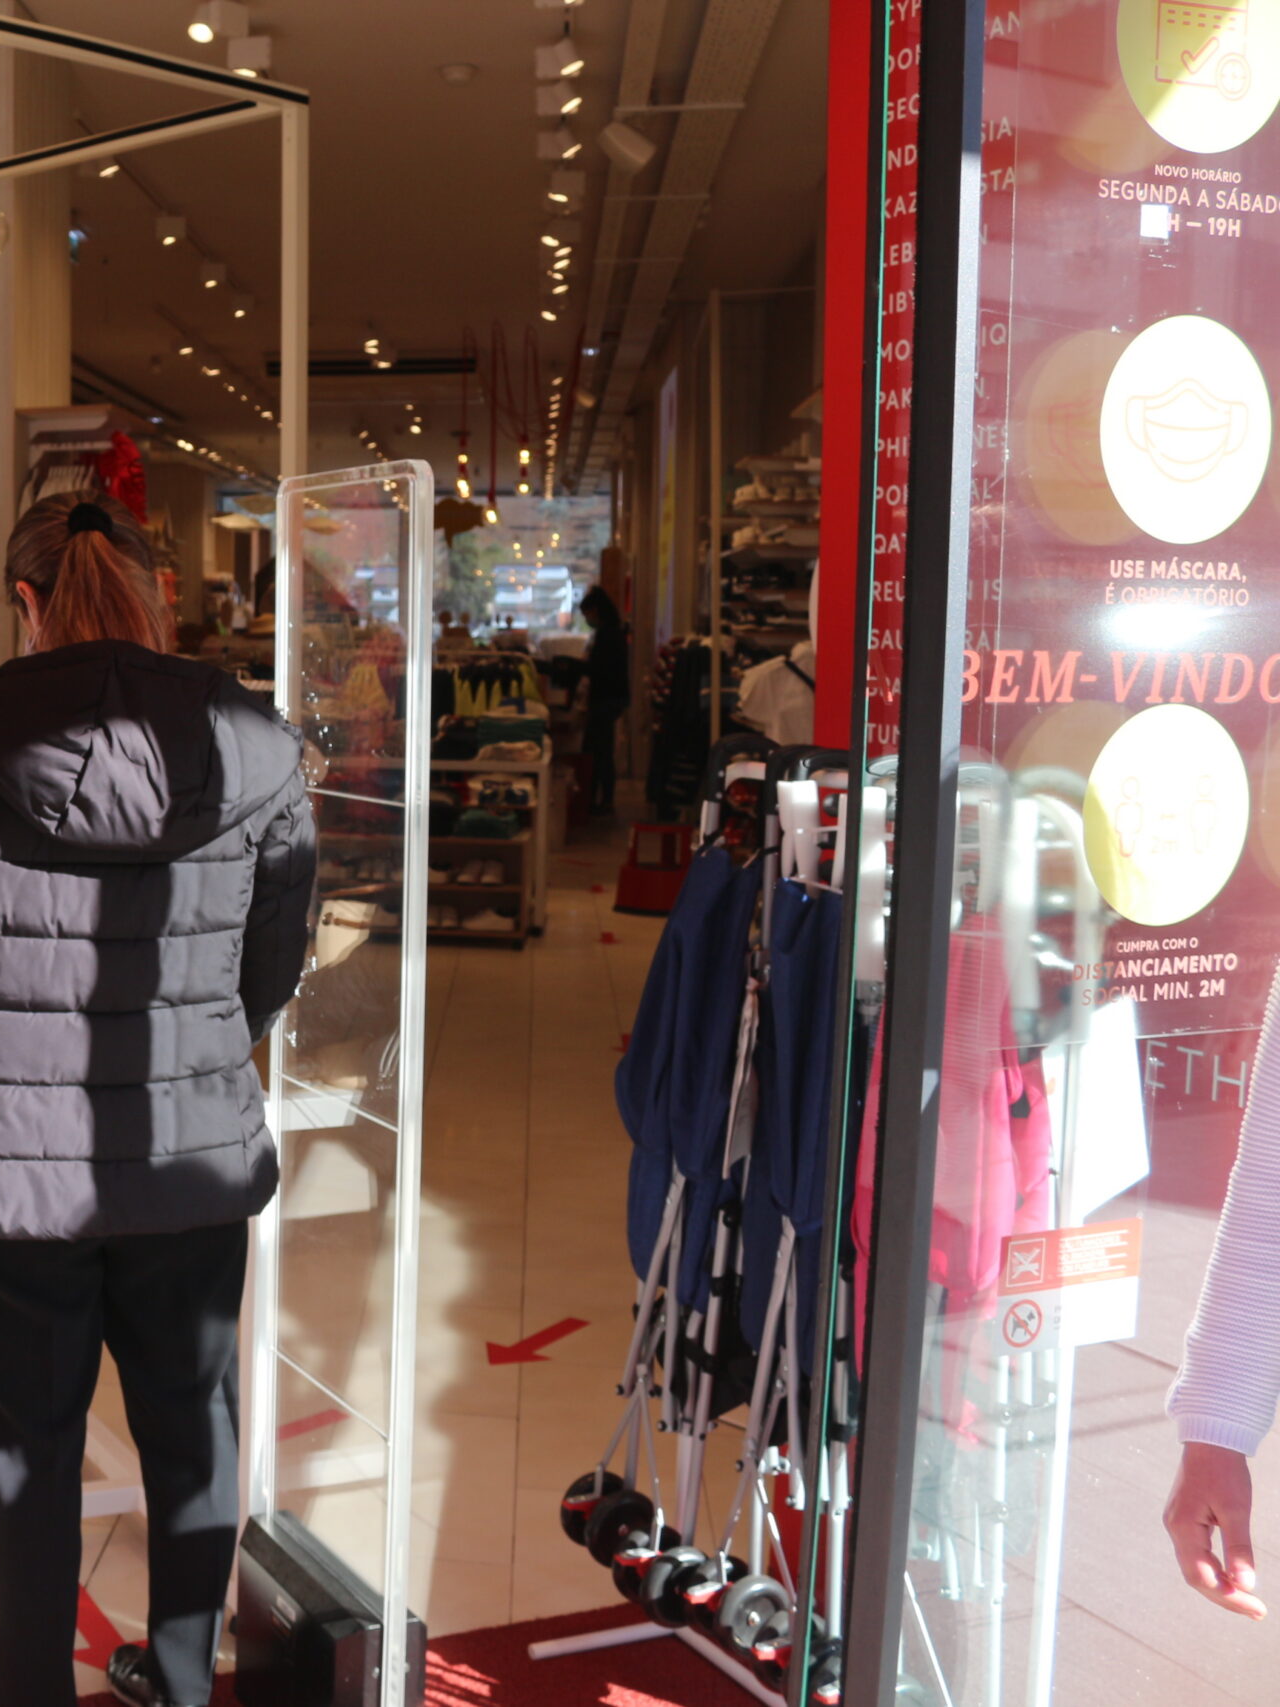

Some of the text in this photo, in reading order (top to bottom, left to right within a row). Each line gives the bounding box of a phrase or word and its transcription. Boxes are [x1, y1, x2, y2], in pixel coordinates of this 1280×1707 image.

[1154, 164, 1242, 184] NOVO HORÁRIO
[1098, 179, 1280, 214] SEGUNDA A SÁBAD
[1208, 217, 1241, 238] 19H
[1109, 556, 1248, 584] USE MÁSCARA,
[1105, 581, 1115, 605] É
[1116, 936, 1199, 953] CUMPRA COM O
[1072, 953, 1238, 981] DISTANCIAMENTO
[1081, 978, 1226, 1006] SOCIAL MIN. 2M
